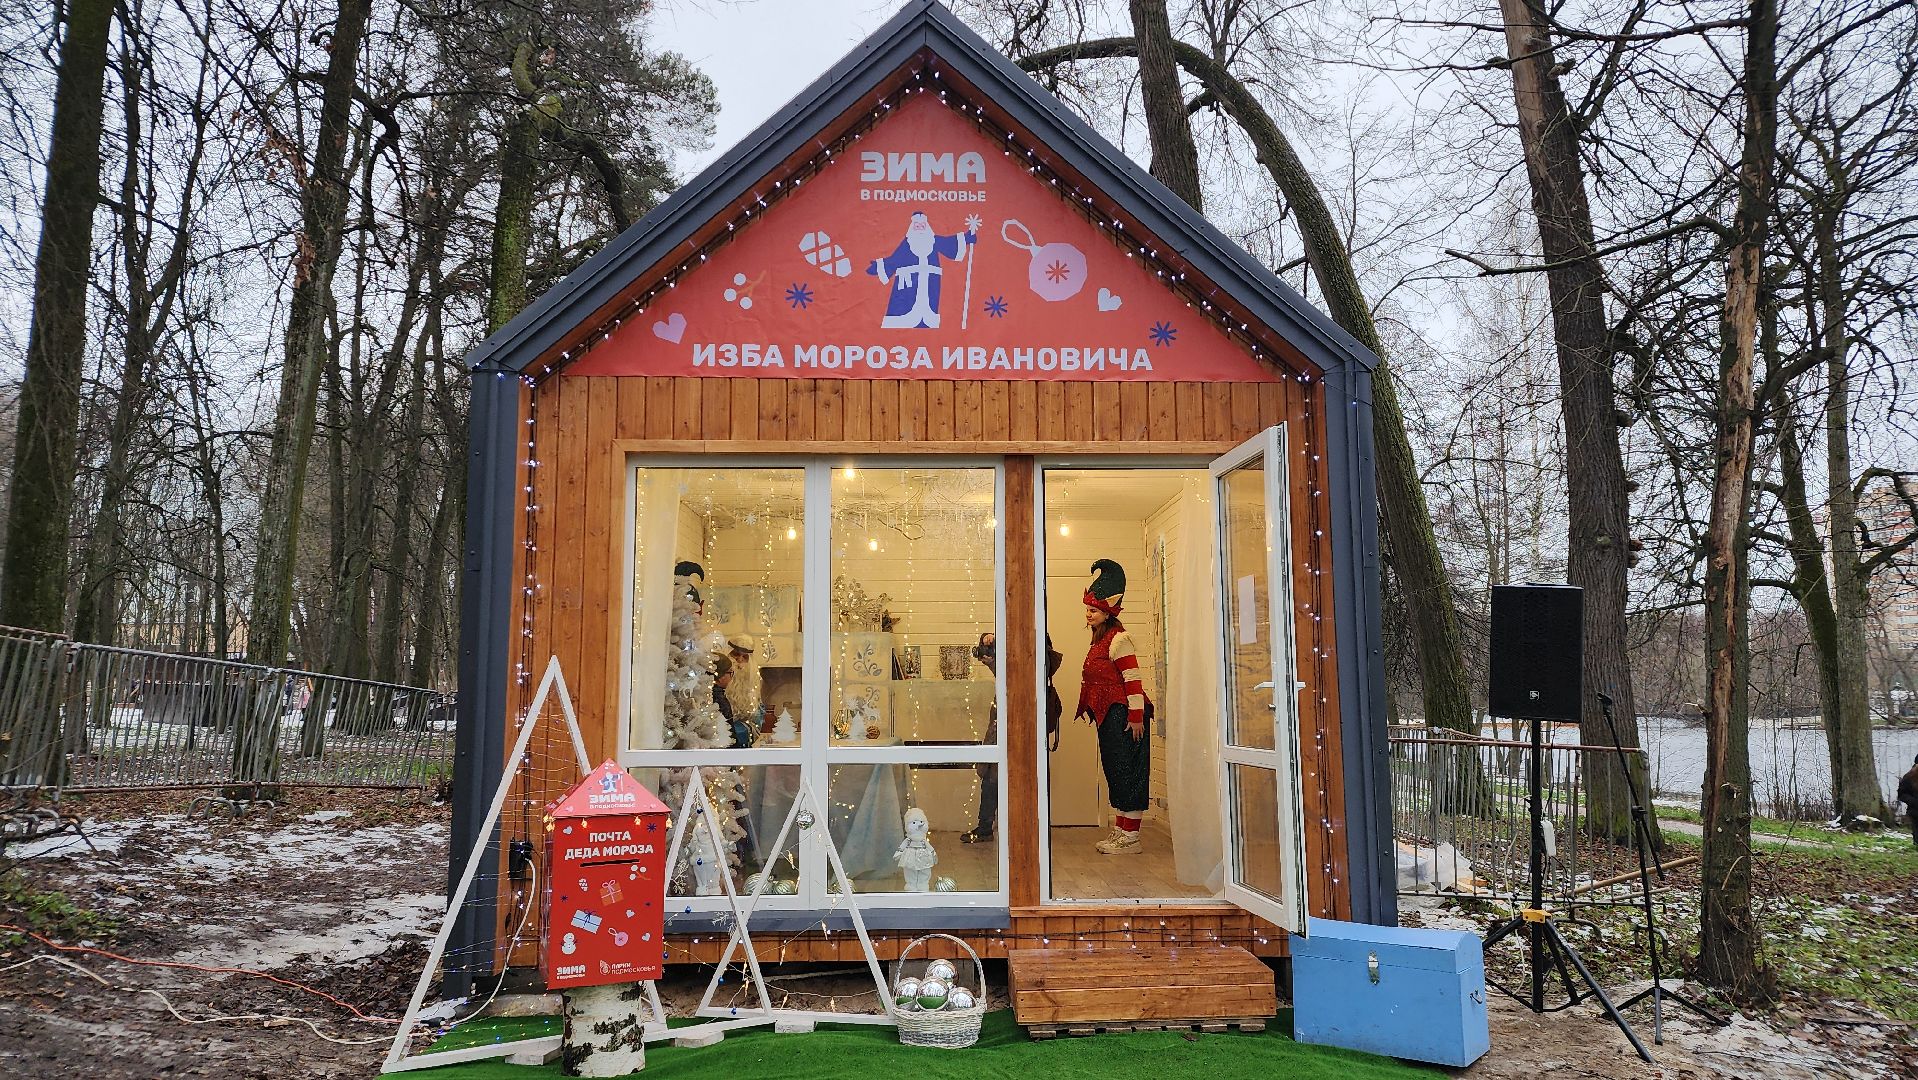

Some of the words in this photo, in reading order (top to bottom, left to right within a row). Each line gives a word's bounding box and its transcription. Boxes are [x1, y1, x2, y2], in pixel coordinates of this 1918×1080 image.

[860, 151, 986, 183] ЗИМА
[860, 189, 871, 201] В
[873, 189, 987, 203] ПОДМОСКОВЬЕ
[692, 343, 785, 368] ИЗБА
[794, 344, 934, 370] МОРОЗА
[942, 346, 1153, 371] ИВАНОВИЧА
[589, 792, 636, 804] ЗИМА
[589, 831, 631, 843] ПОЧТА
[564, 847, 600, 860] ДЕДА
[602, 844, 654, 857] МОРОЗА
[556, 964, 586, 975] ЗИМА
